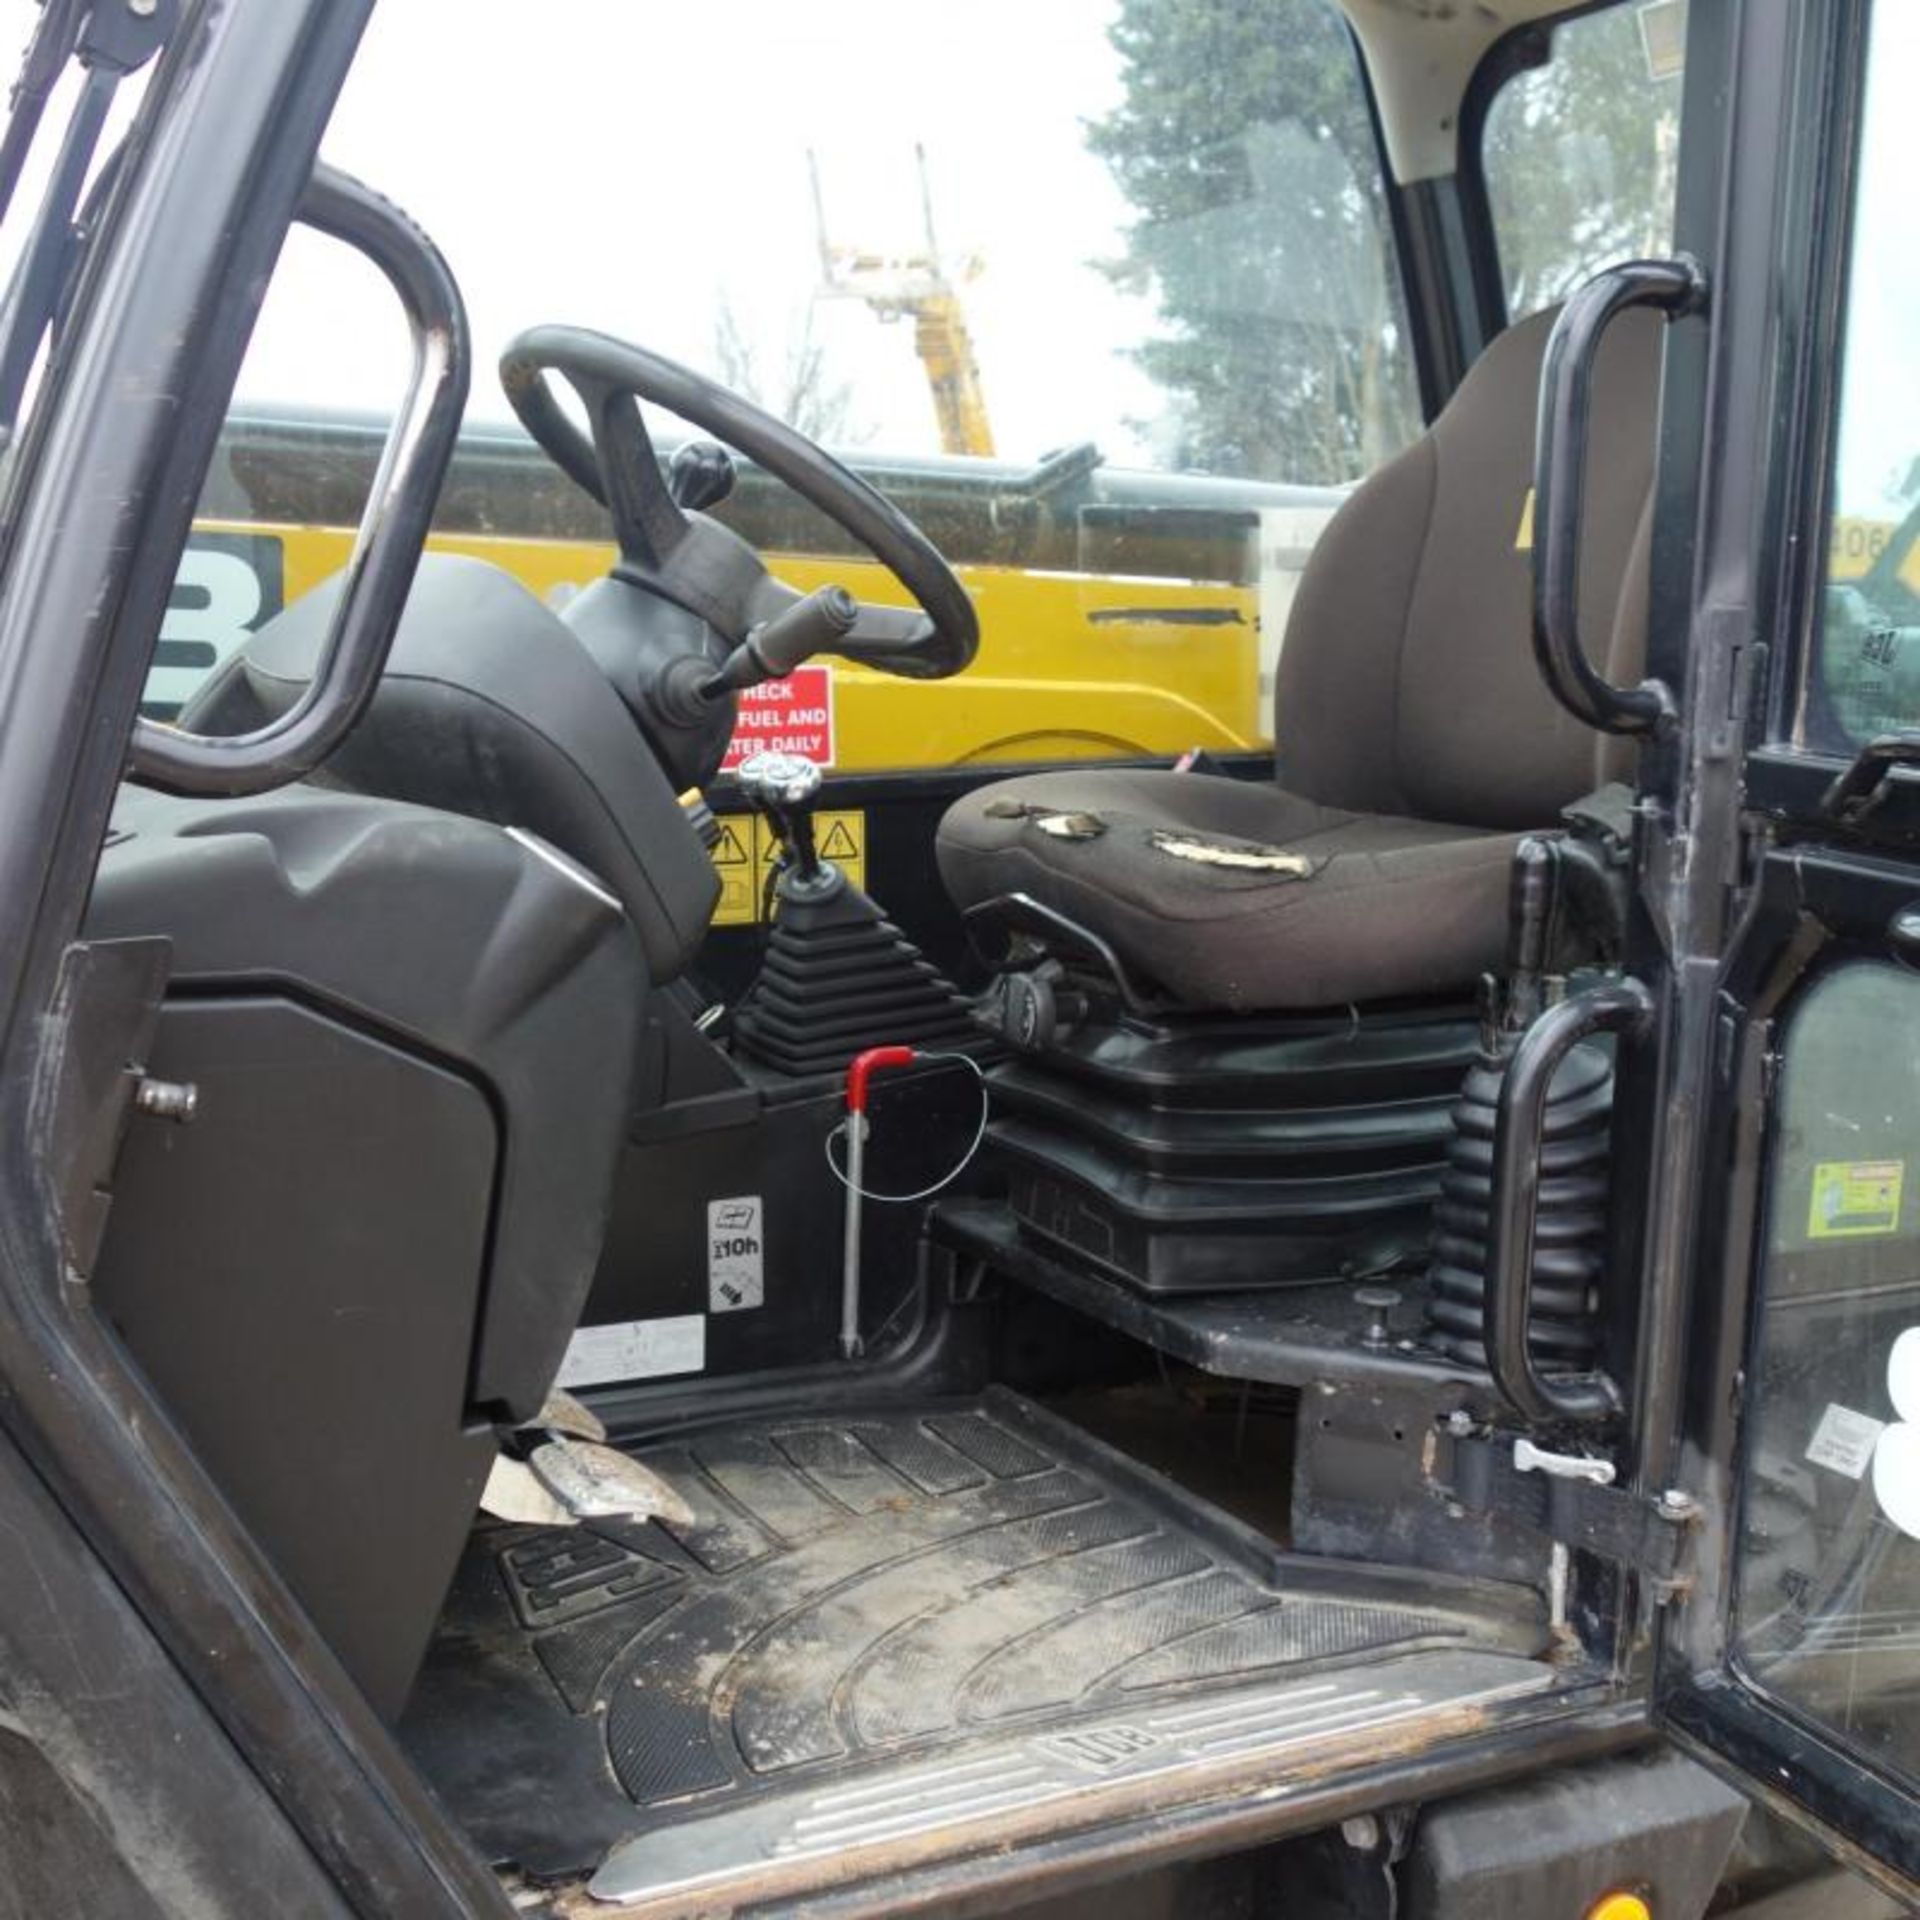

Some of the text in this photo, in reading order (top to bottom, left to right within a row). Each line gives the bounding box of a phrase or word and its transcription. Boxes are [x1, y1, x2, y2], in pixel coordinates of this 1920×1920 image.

[739, 708, 826, 727] FUEL AND
[726, 734, 822, 754] TER DAILY
[1057, 1728, 1157, 1765] JCB
